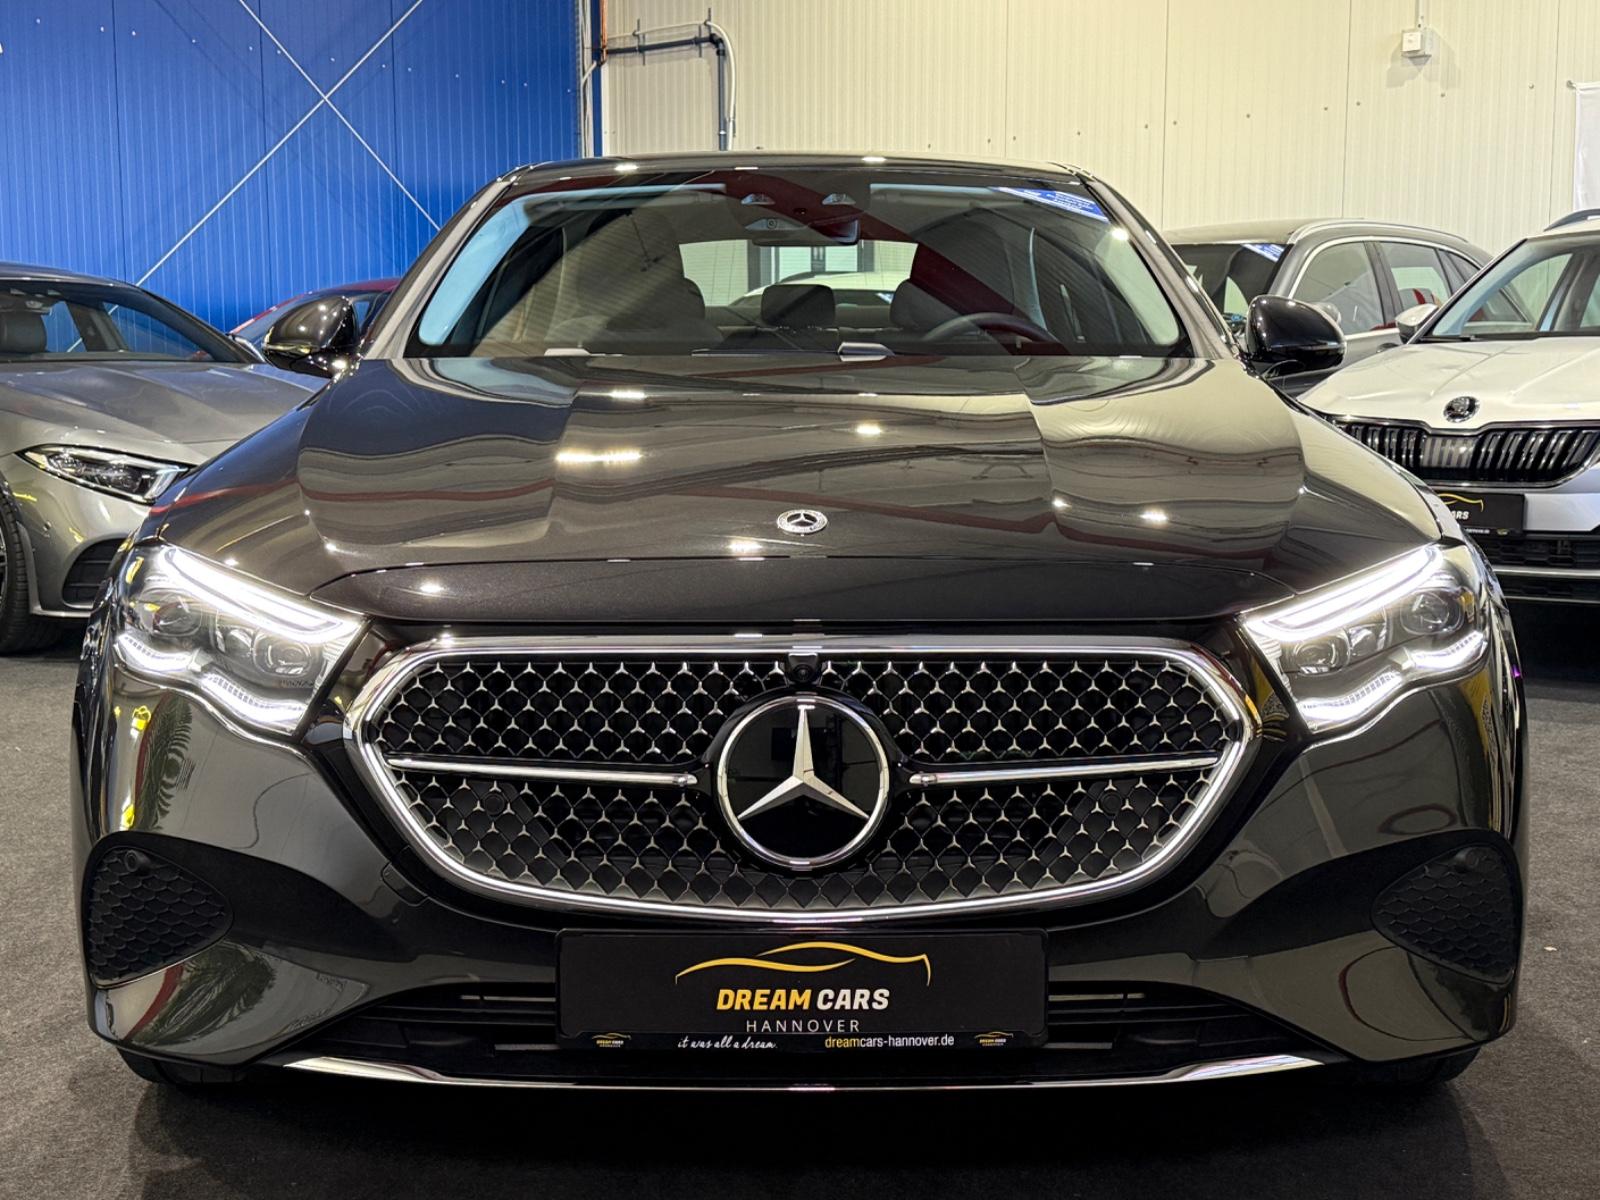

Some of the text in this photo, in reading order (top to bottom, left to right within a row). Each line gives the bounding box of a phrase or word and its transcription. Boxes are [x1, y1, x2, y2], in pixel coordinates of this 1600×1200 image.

[716, 988, 890, 1010] DREAM CARS
[746, 1019, 860, 1033] HANNOVER
[713, 1035, 733, 1049] all
[824, 1034, 955, 1049] dreamcars-hannover.de
